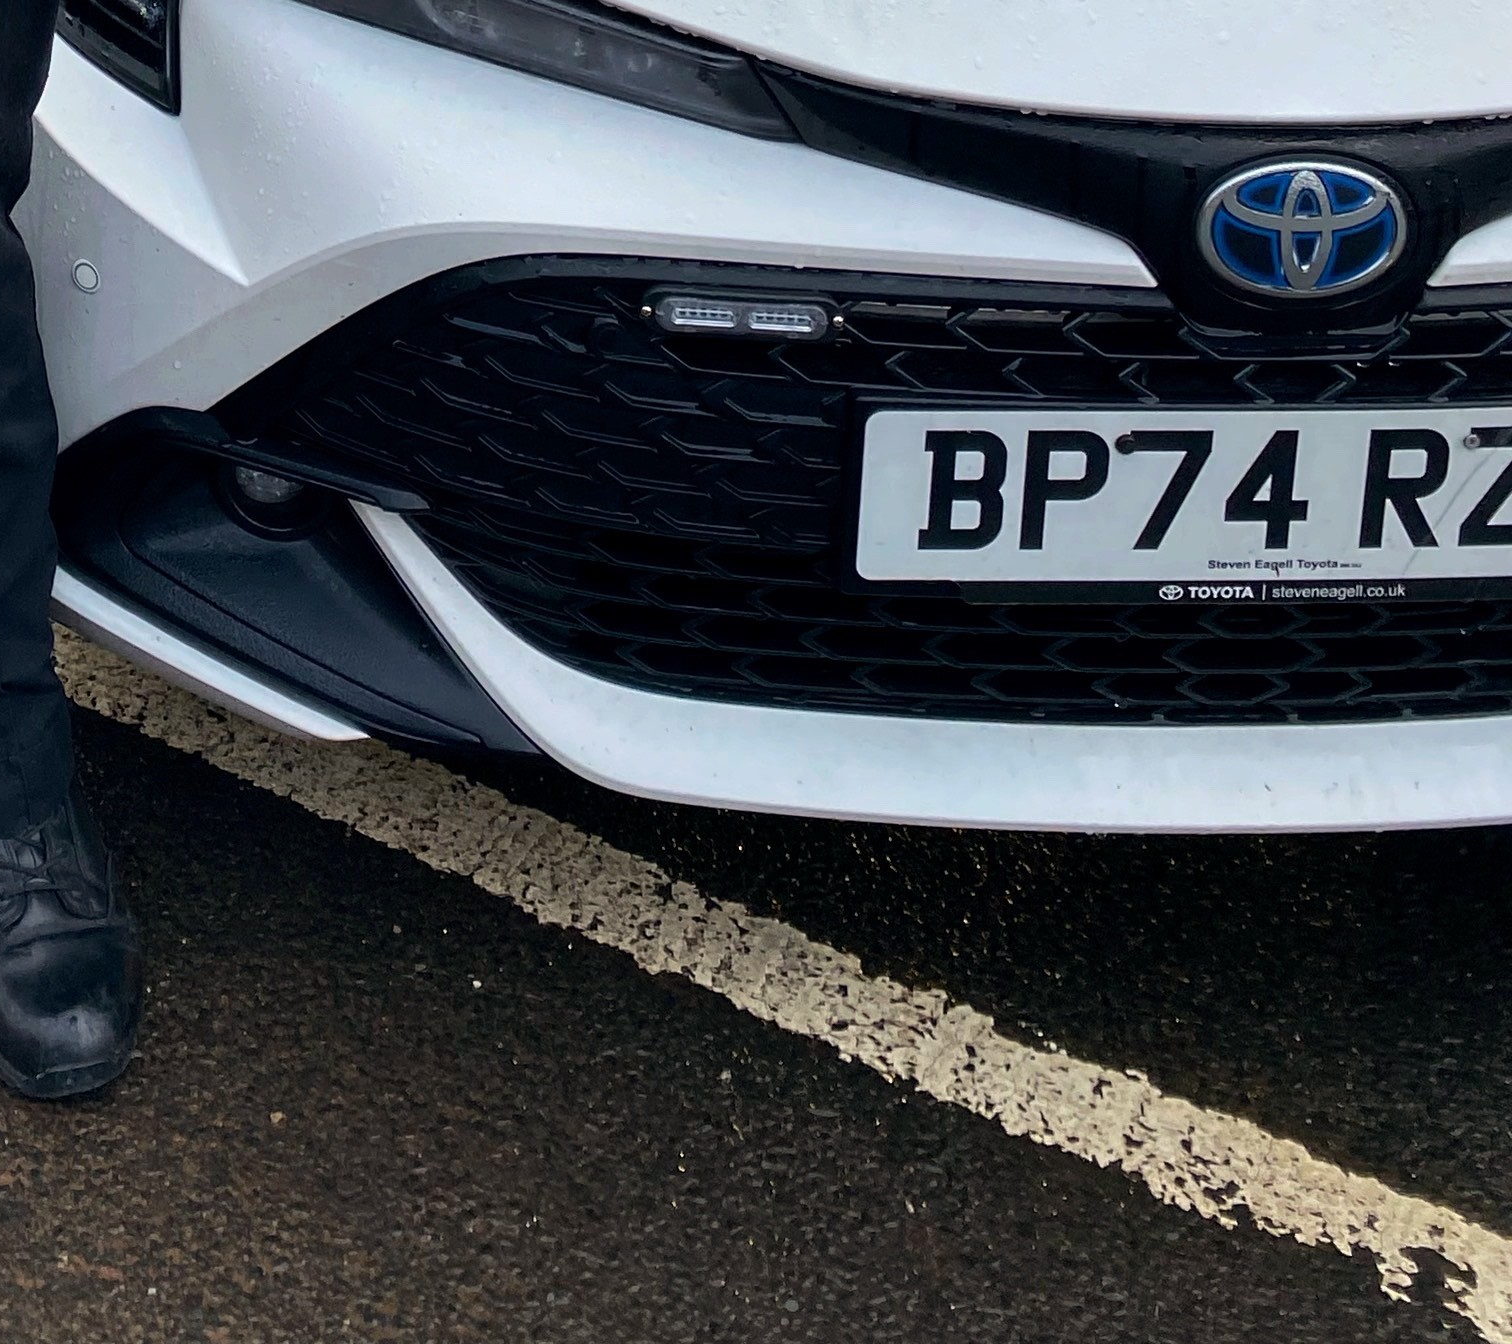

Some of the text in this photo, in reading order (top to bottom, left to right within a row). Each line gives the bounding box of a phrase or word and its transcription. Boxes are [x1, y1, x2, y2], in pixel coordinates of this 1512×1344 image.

[917, 428, 1512, 551] BP74 RZ
[1207, 559, 1251, 570] Steven
[1254, 559, 1293, 571] Eagell
[1297, 559, 1338, 571] Toyota
[1188, 583, 1406, 600] TOYOTA steveneagell.co.uk
